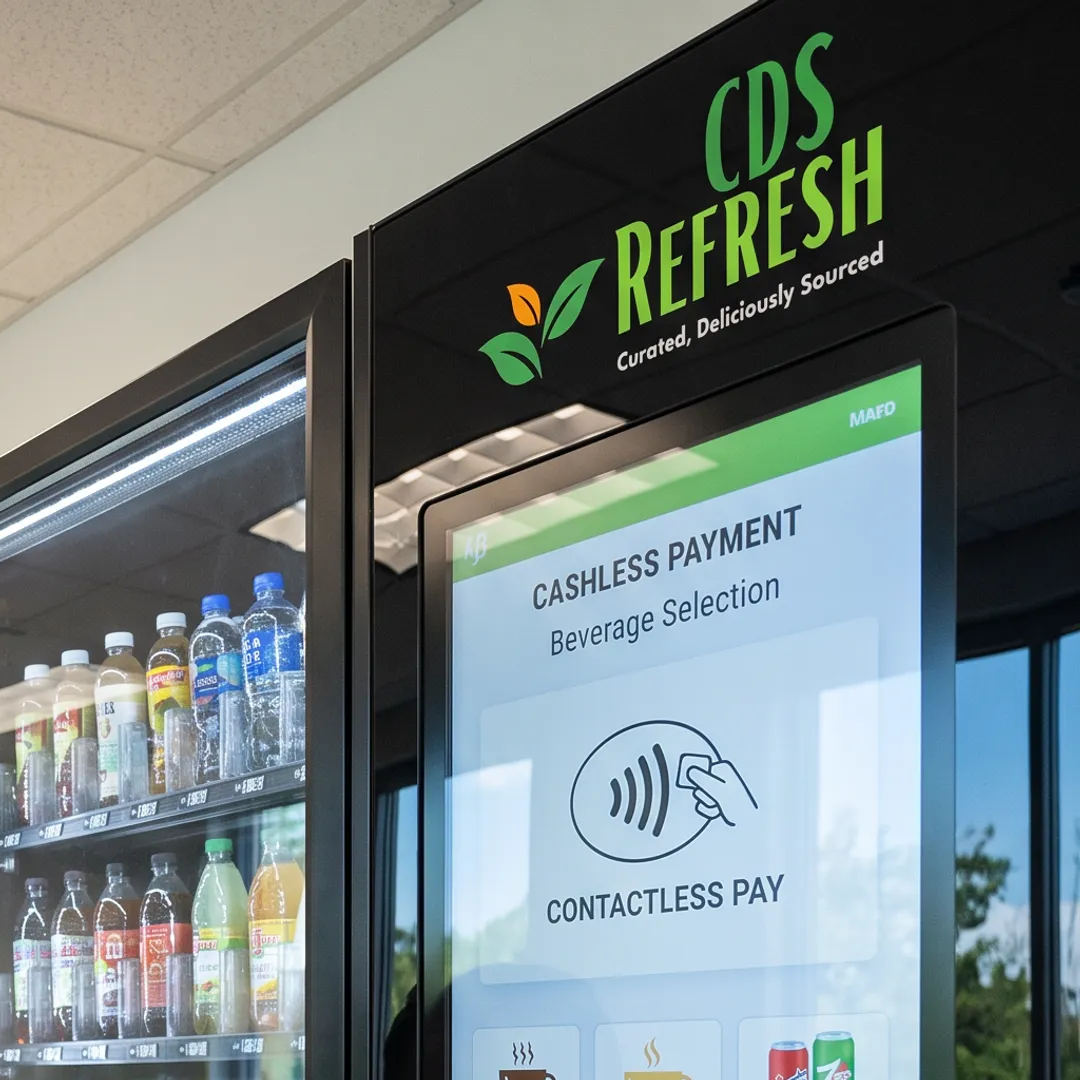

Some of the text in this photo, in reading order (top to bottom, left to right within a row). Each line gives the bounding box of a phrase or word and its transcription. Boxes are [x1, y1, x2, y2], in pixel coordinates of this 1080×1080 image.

[705, 31, 835, 193] CDS
[615, 124, 883, 335] REFRESH
[616, 239, 884, 372] Curated, Deliciously Sourced
[532, 547, 660, 611] CASHLESS
[667, 504, 803, 572] PAYMENT
[550, 573, 781, 657] Beverage Selection
[546, 873, 786, 924] CONTACTLESS PAY
